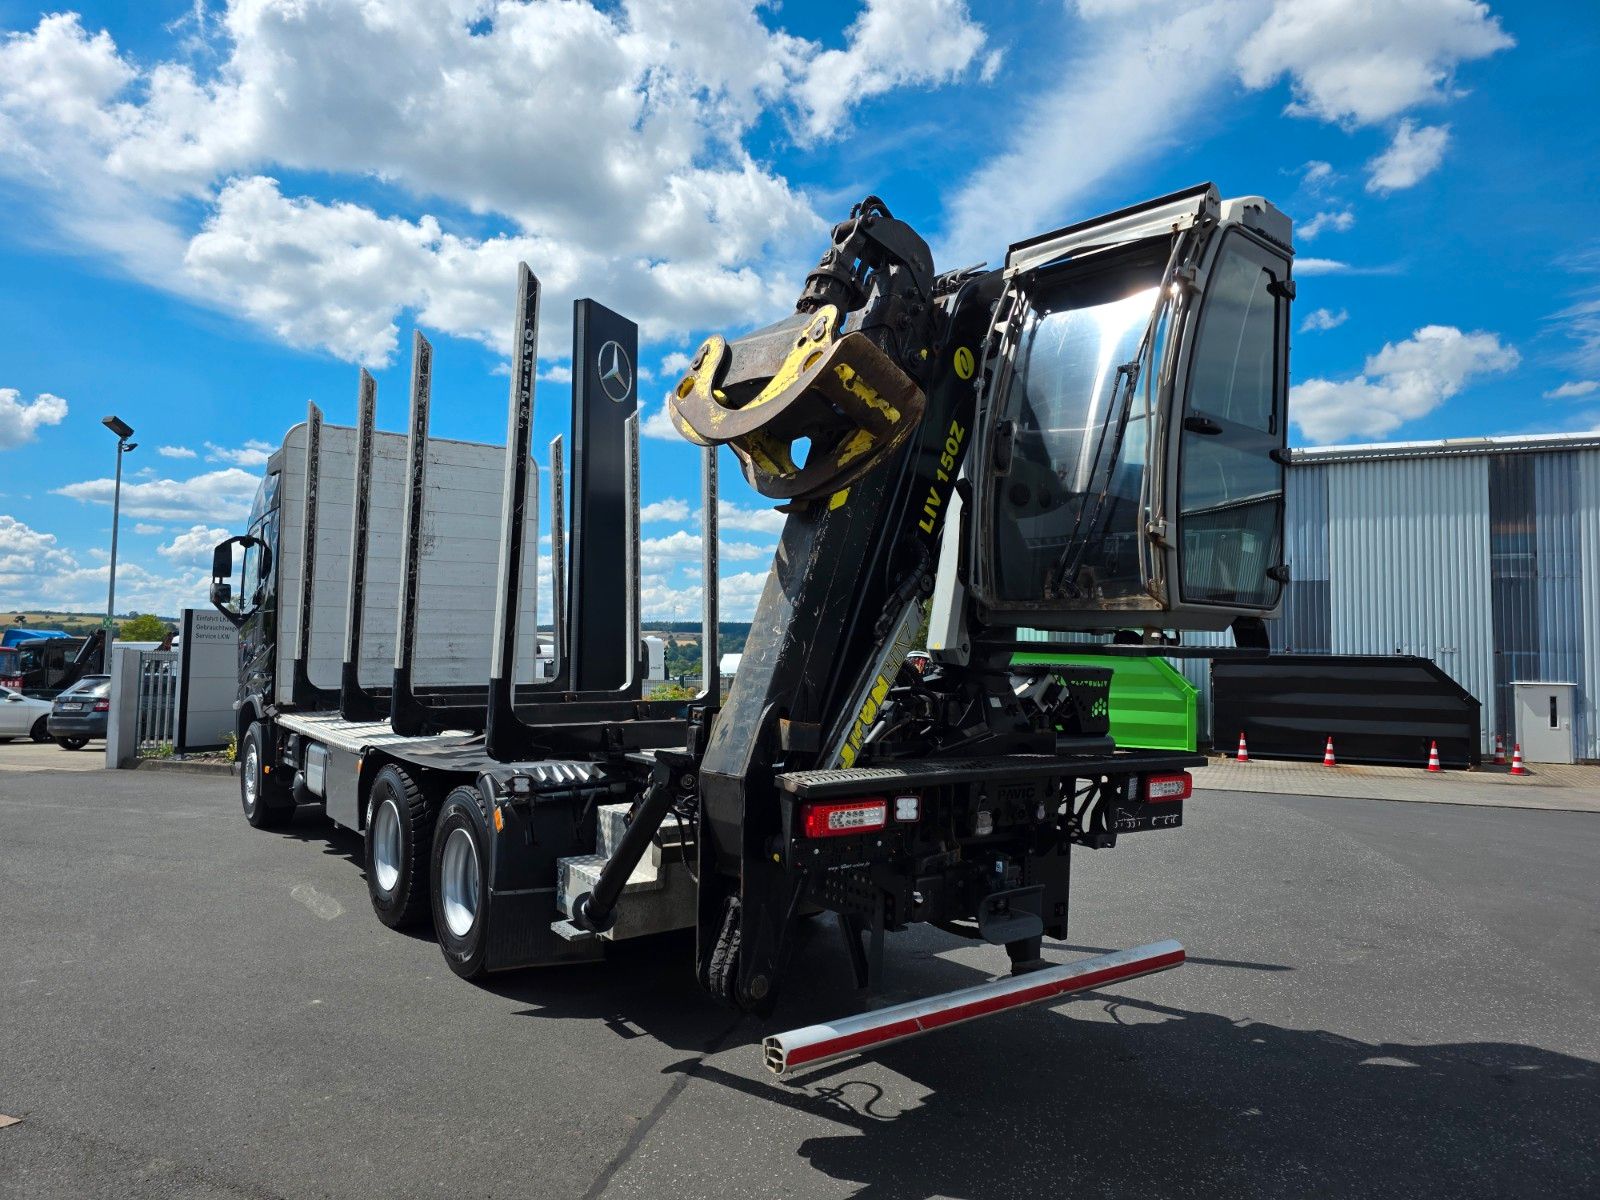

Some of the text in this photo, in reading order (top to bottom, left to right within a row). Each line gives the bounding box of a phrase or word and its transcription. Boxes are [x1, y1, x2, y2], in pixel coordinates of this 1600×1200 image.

[918, 419, 965, 535] LIV 150Z
[1000, 787, 1036, 800] PAVIC
